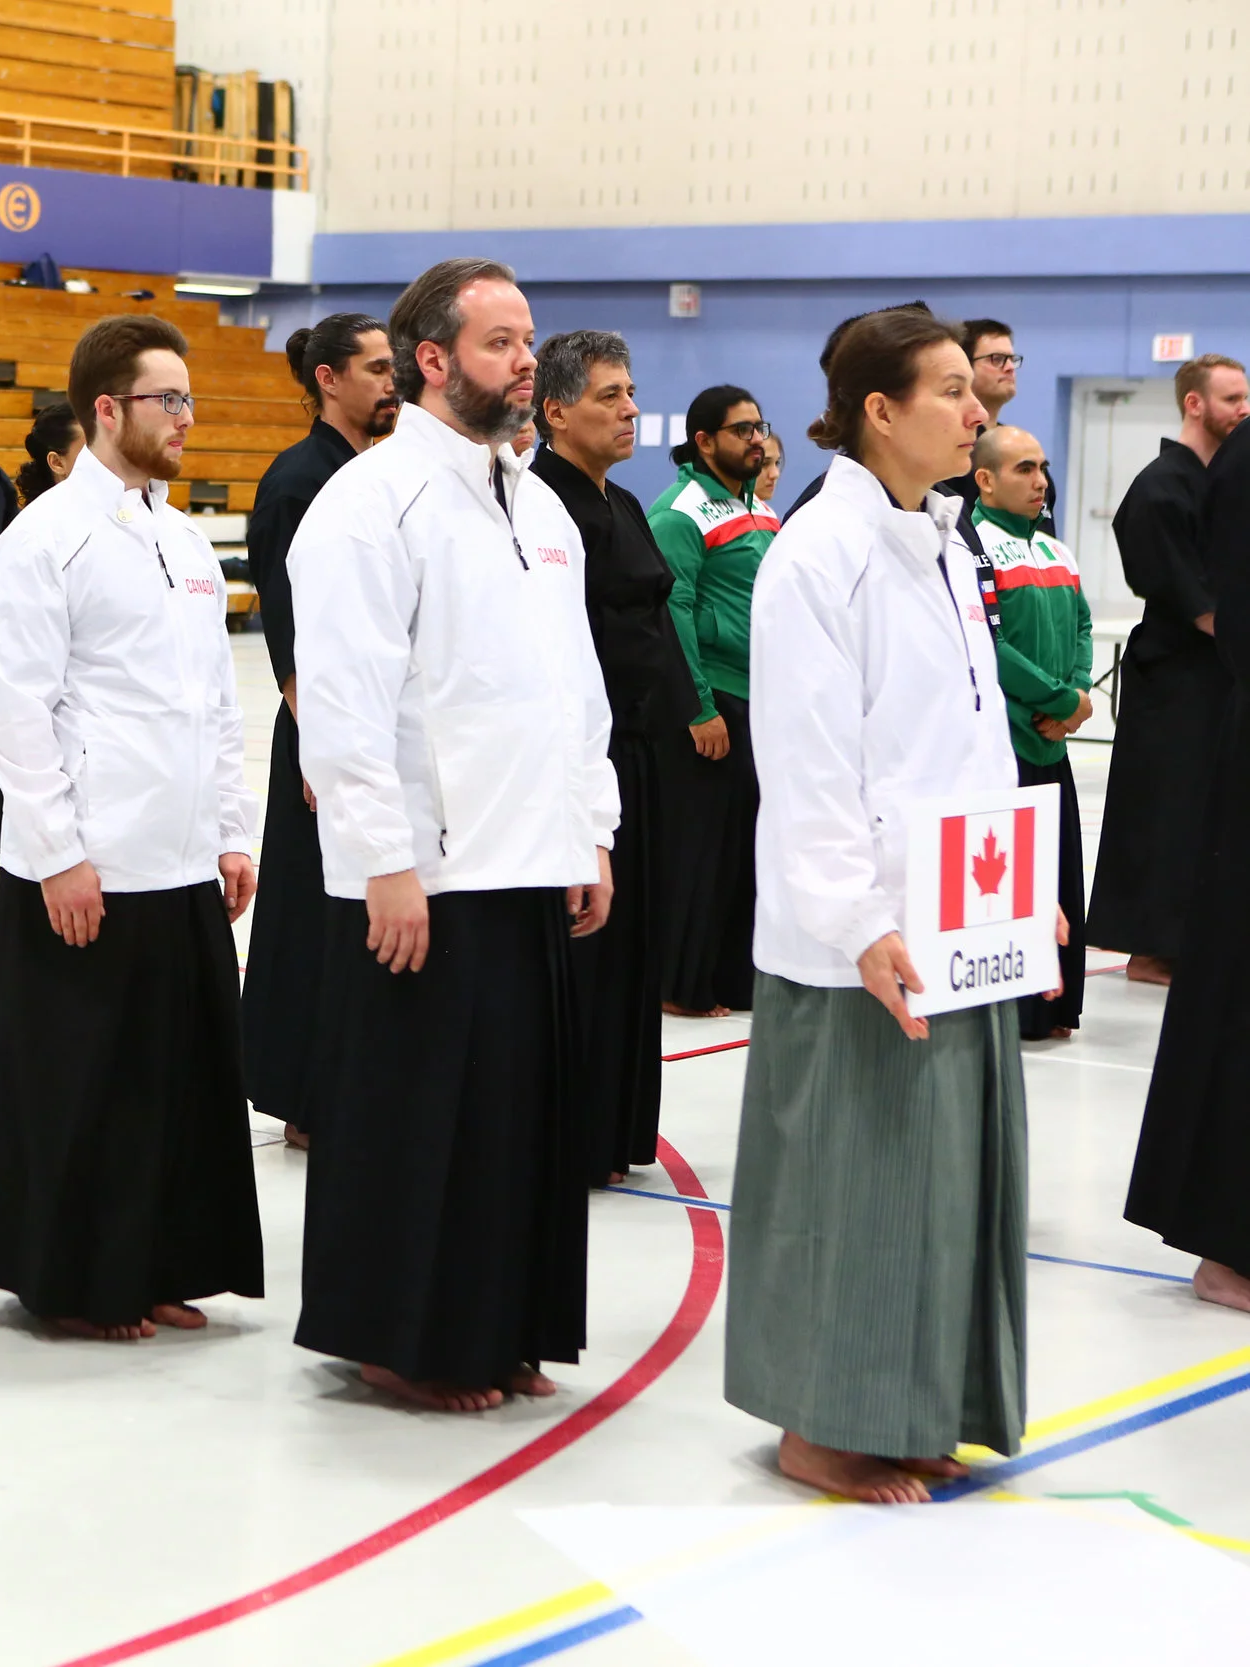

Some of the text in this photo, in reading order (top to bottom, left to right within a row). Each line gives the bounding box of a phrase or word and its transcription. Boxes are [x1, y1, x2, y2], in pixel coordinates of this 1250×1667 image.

[992, 540, 1027, 565] EXICO
[185, 578, 216, 596] CANADA
[950, 940, 1024, 992] Canada
